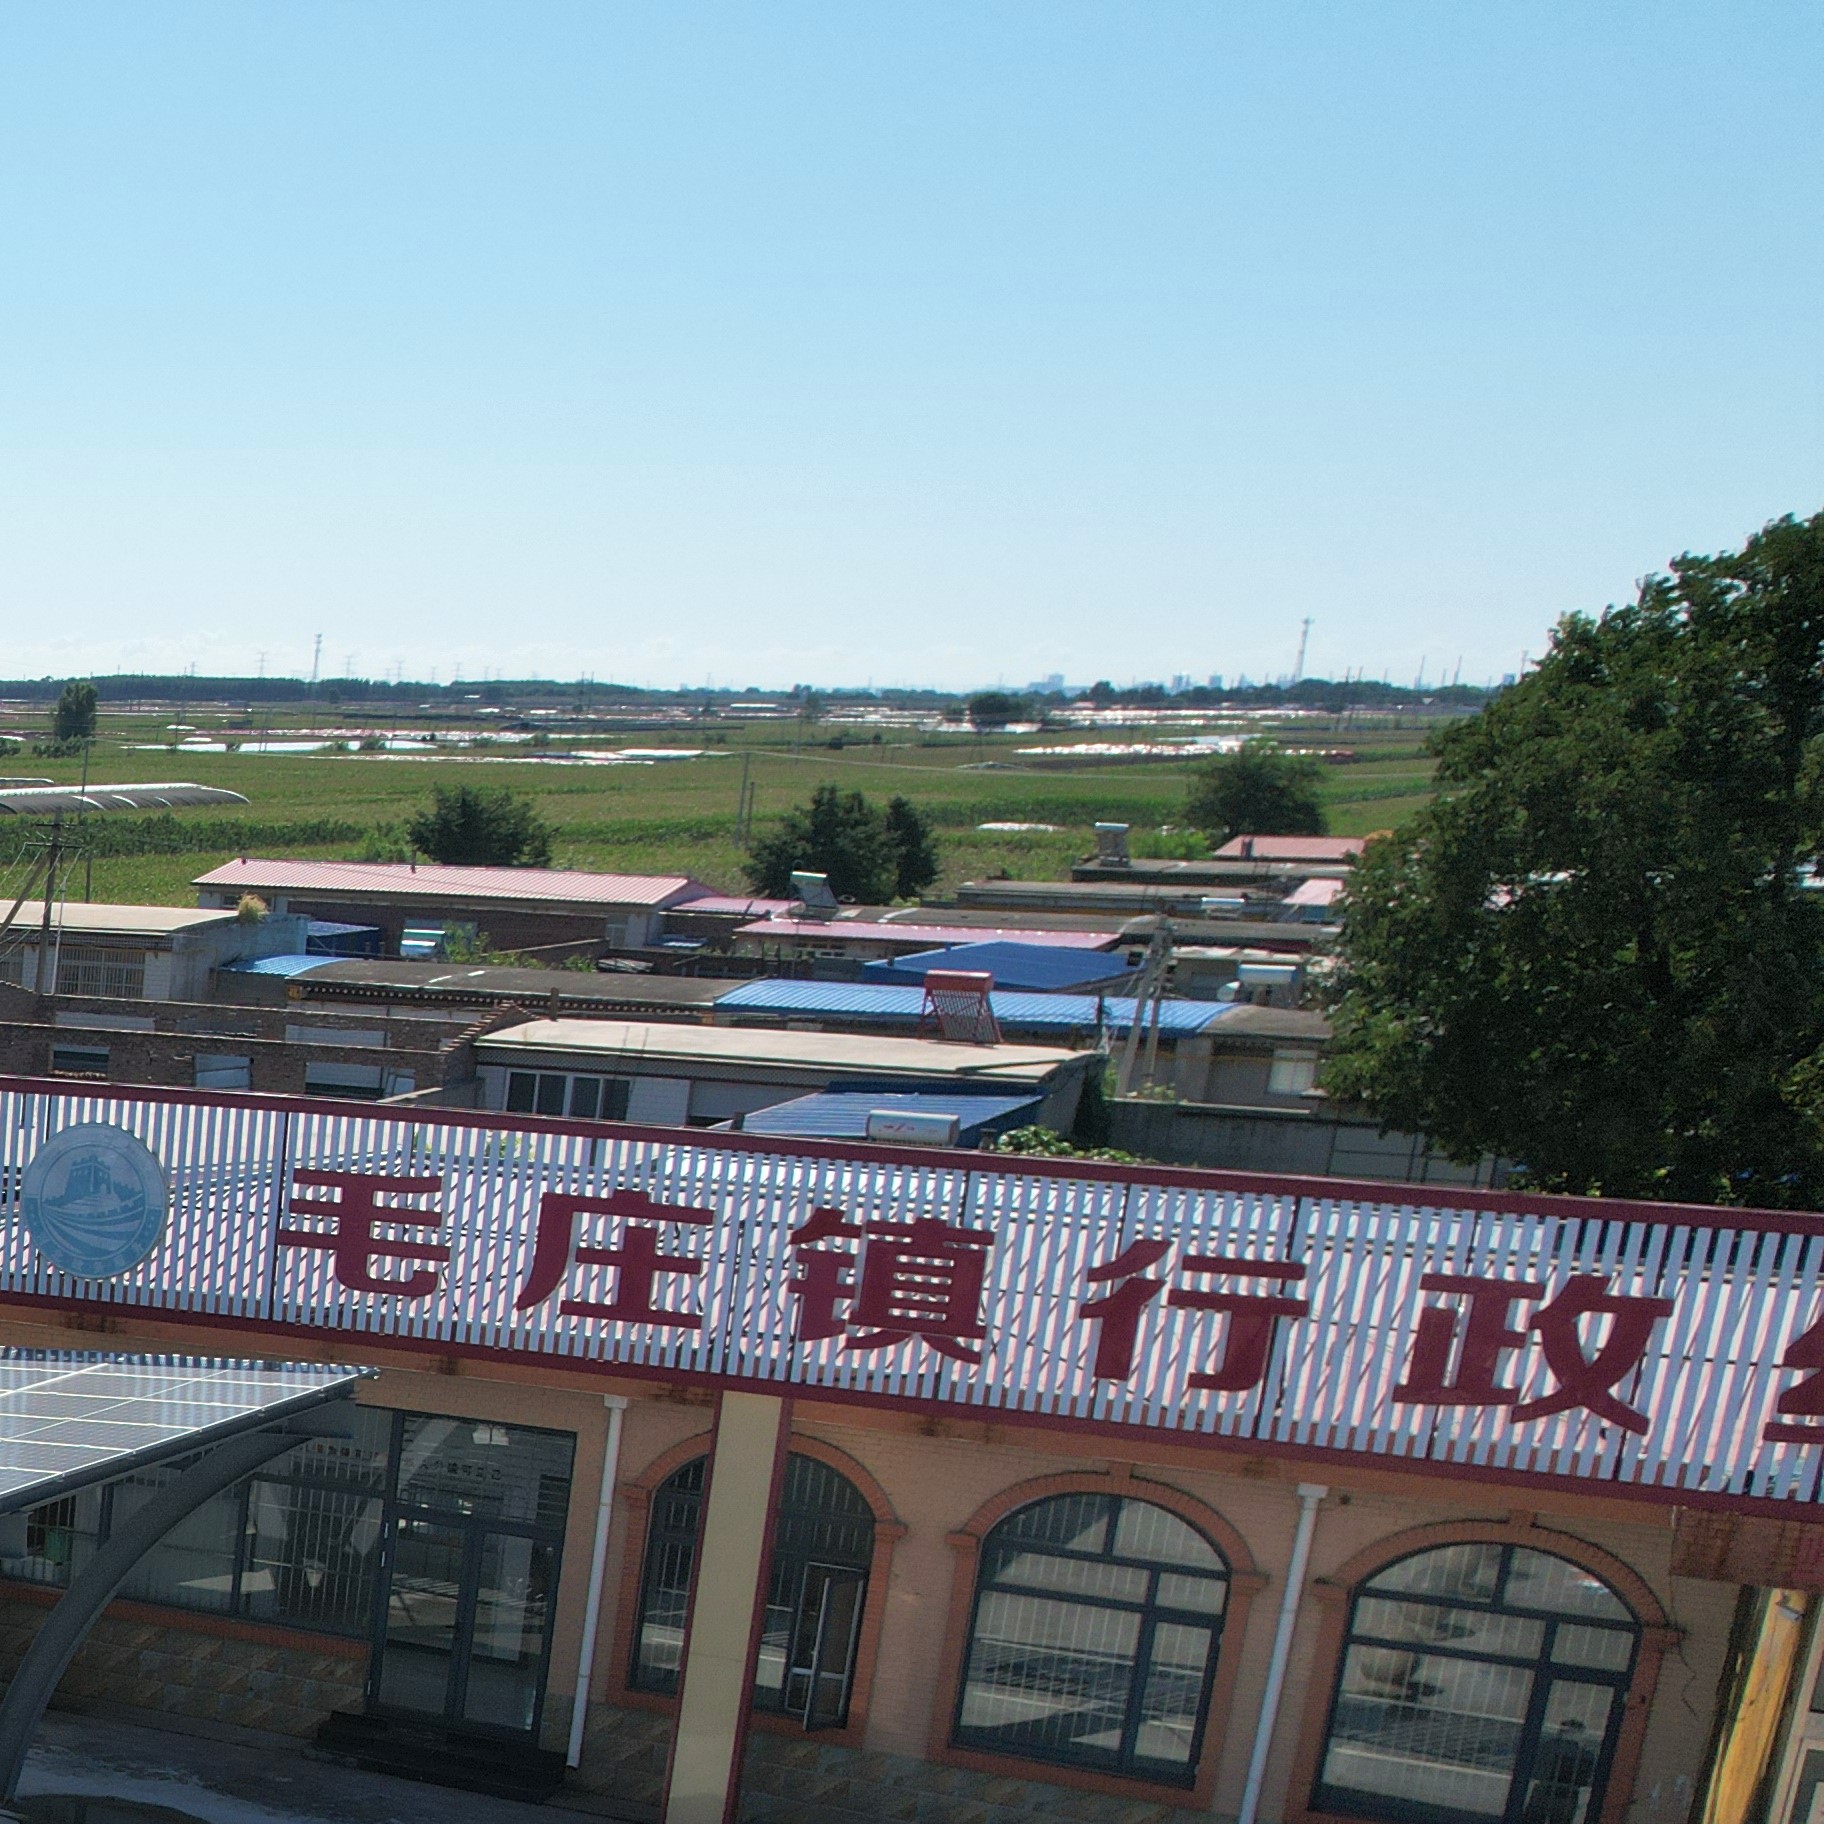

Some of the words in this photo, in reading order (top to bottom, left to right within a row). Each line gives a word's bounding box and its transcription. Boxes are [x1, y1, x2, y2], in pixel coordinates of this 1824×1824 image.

[278, 1165, 1824, 1445] 毛庄镇行政
